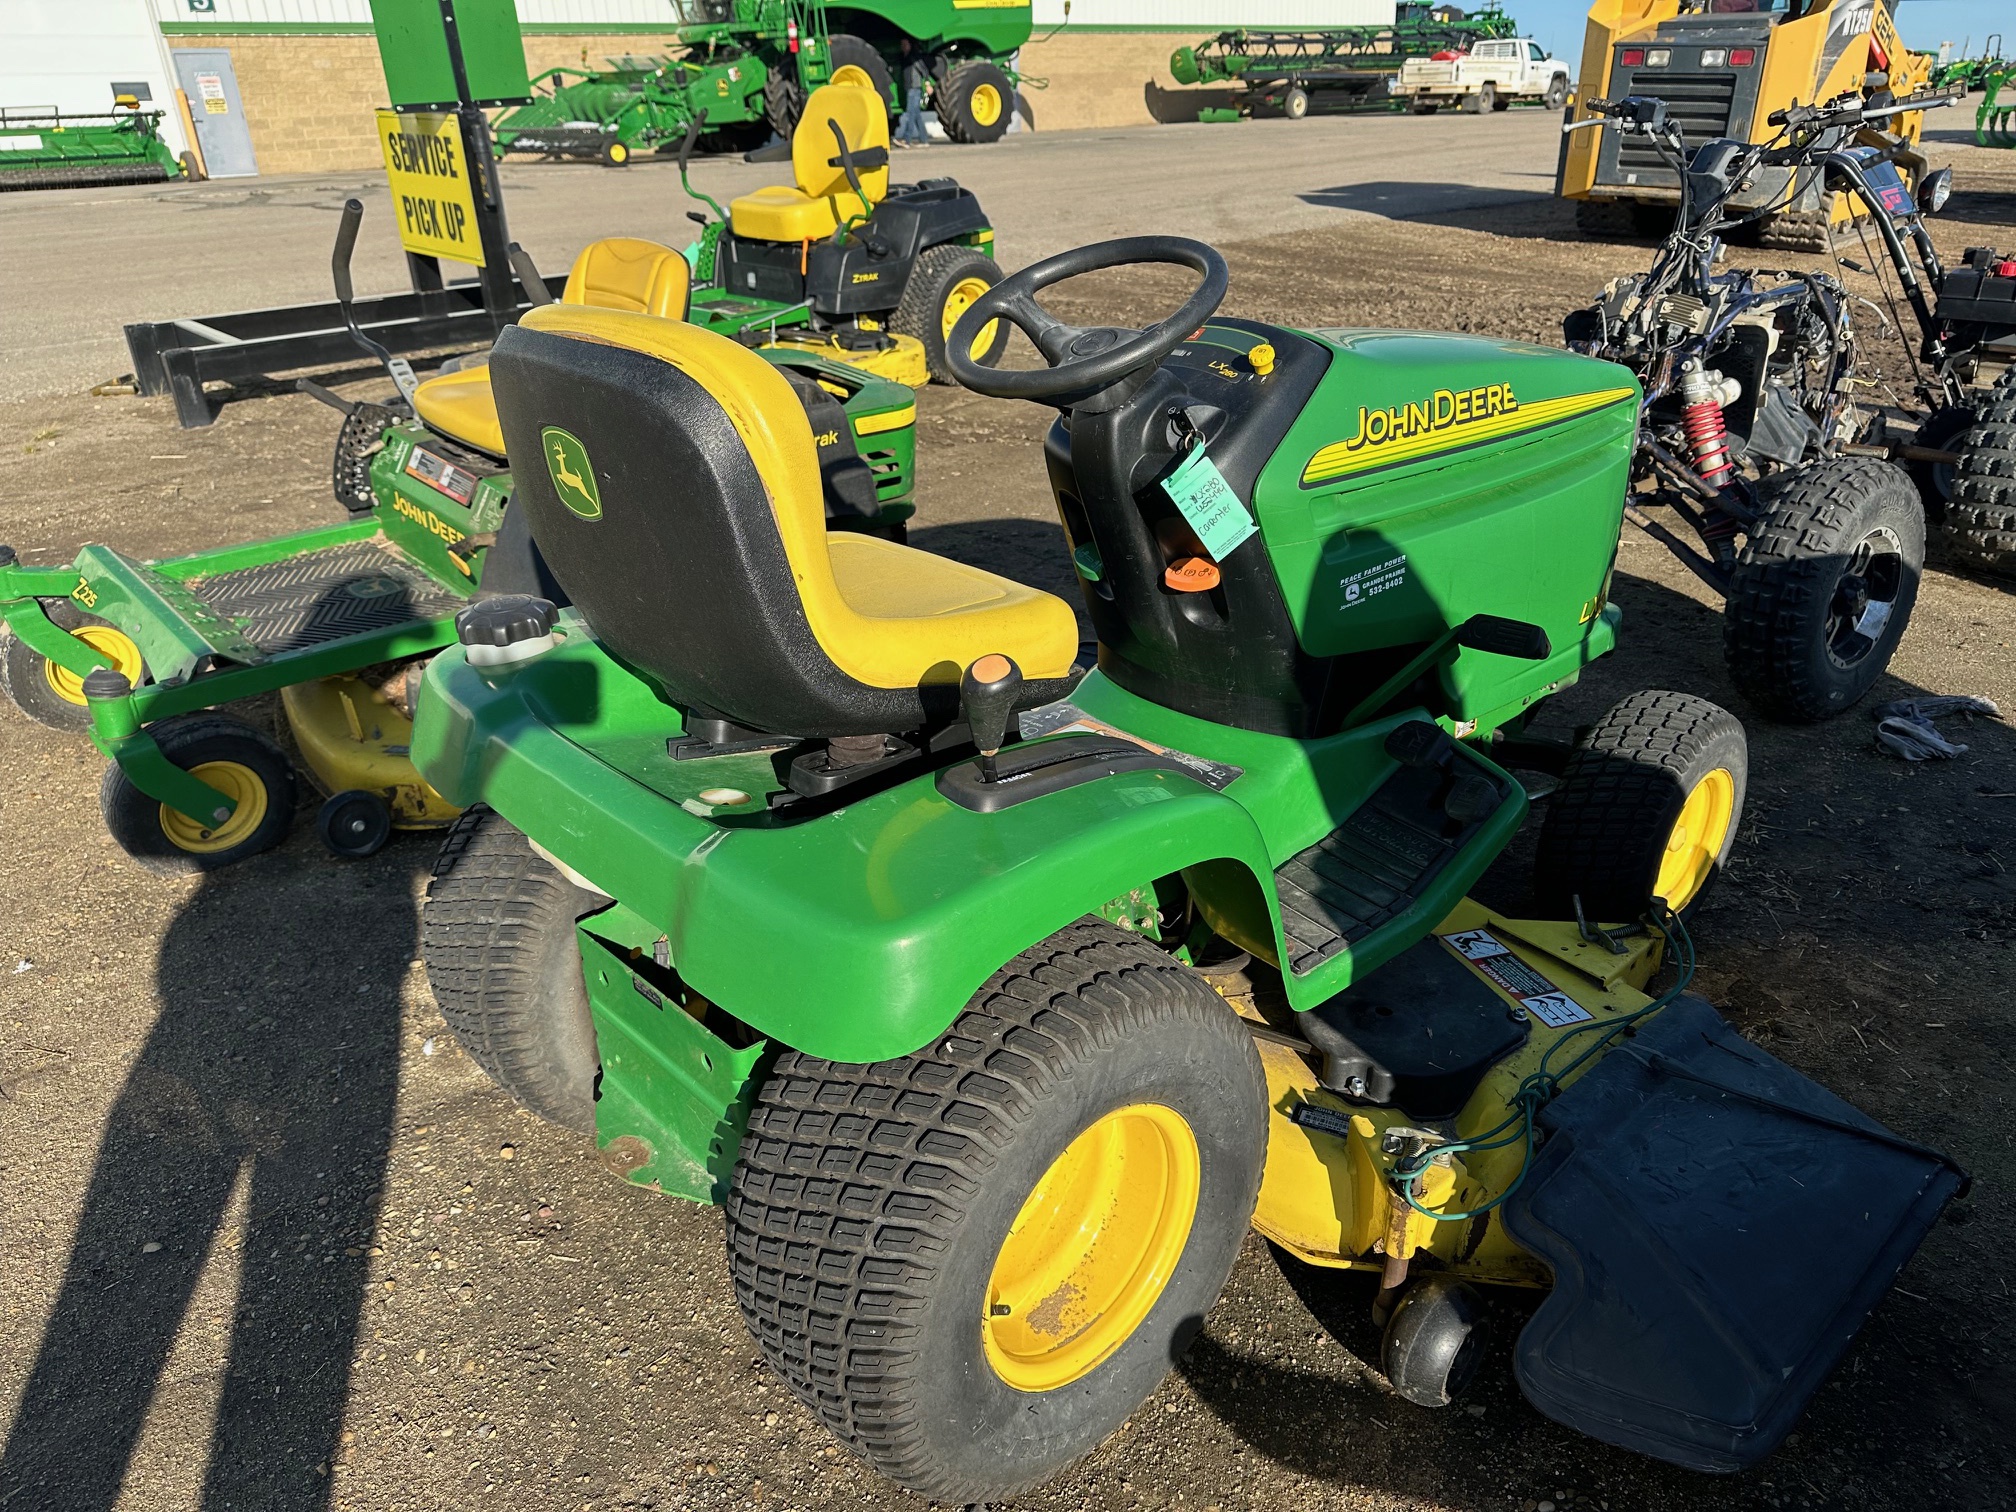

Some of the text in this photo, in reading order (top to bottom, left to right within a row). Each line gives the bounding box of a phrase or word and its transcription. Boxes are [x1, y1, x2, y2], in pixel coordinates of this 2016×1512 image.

[1876, 9, 1896, 56] GEHL
[388, 131, 459, 179] SERVICE
[402, 195, 466, 243] PICK UP
[852, 272, 879, 284] ZTRAK
[1346, 381, 1519, 452] JOHN DEERE
[393, 490, 429, 529] JOHN
[1340, 554, 1407, 586] PEACE FARM POWER
[1362, 567, 1406, 589] GRANDE PRAIRIE
[1369, 576, 1403, 596] 532-8402
[72, 576, 98, 608] Z225
[1479, 963, 1510, 988] DANGER
[1314, 1106, 1333, 1115] JOHN
